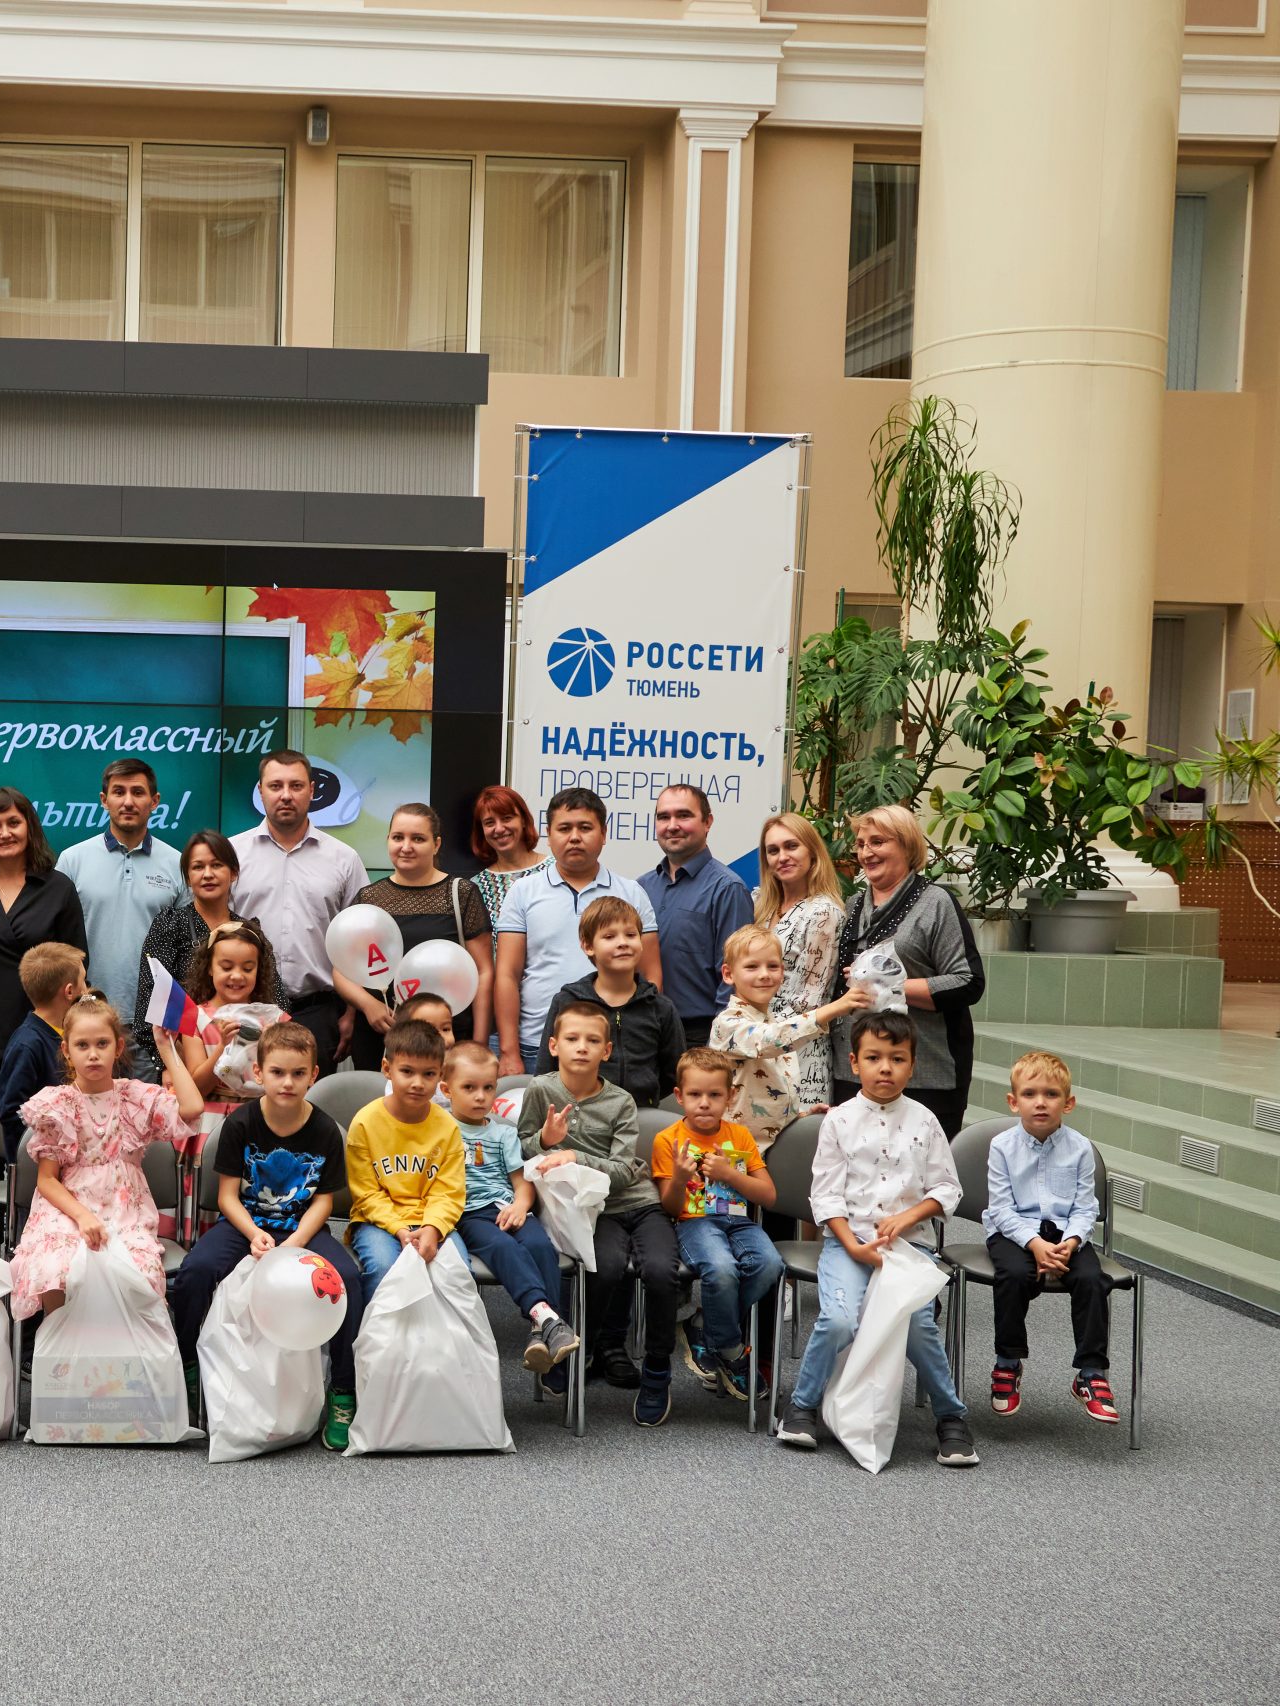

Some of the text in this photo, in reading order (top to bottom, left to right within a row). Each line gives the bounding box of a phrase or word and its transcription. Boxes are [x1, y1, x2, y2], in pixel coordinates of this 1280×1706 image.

[627, 641, 764, 673] РОССЕТИ
[627, 679, 700, 699] ТЮМЕНЬ
[541, 722, 765, 767] НАДЁЖНОСТЬ,
